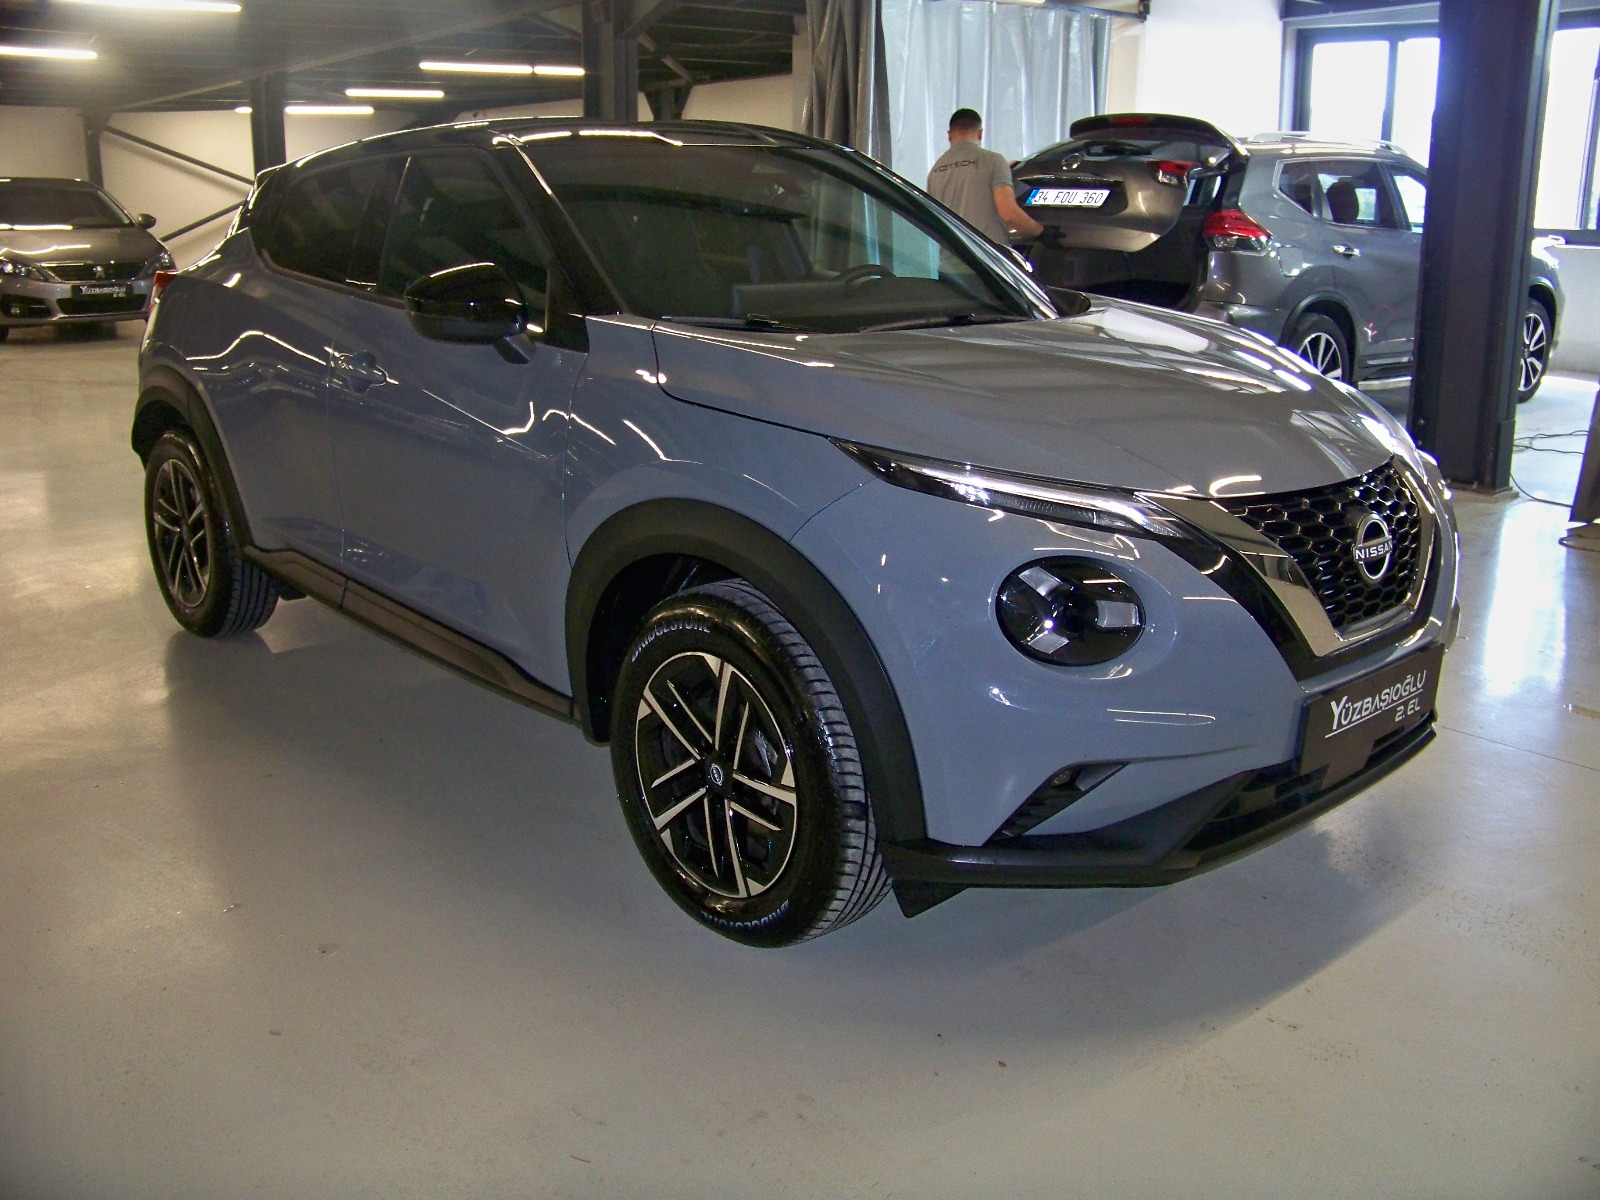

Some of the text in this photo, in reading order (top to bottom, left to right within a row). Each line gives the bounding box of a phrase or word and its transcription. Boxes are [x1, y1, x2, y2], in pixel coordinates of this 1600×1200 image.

[1034, 190, 1049, 203] 34
[1080, 192, 1104, 204] 360
[1354, 540, 1393, 561] NISSAN
[1329, 669, 1427, 731] YÜZBAŞIOĞLU
